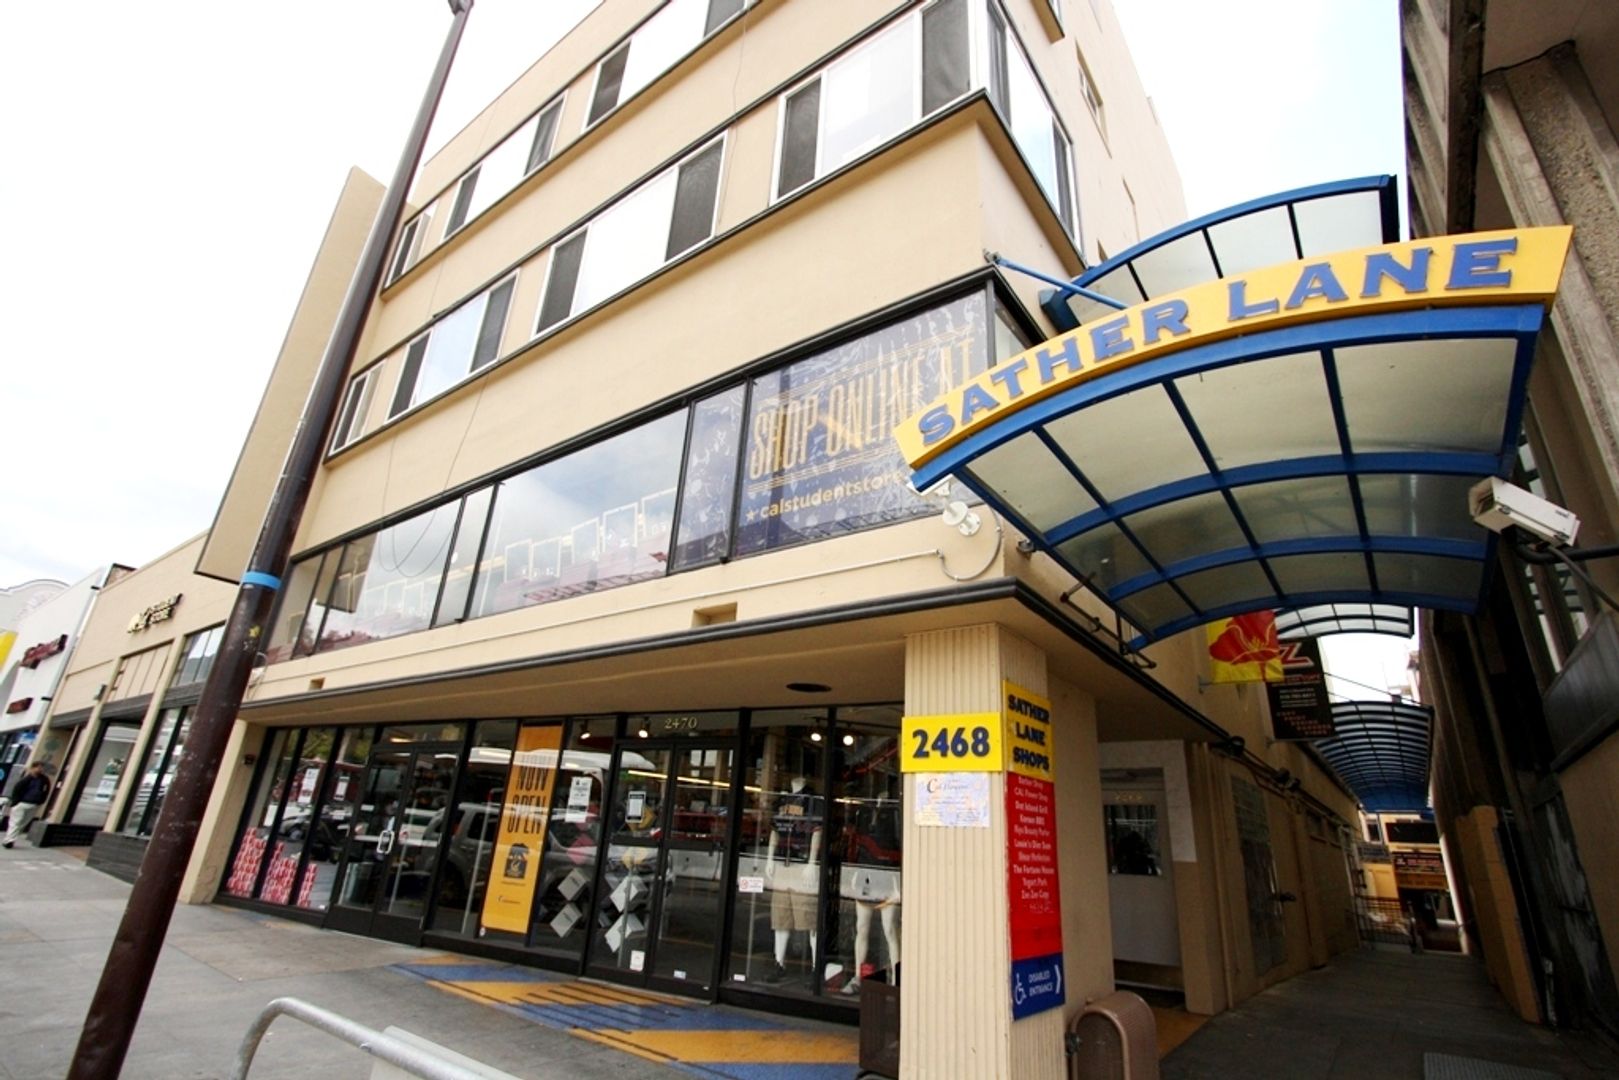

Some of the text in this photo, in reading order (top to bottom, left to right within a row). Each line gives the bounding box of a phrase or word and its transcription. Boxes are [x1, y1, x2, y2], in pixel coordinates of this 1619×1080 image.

[918, 236, 1519, 446] SATHER LANE
[751, 392, 819, 480] SHOP
[825, 350, 925, 457] ONLINE
[664, 717, 698, 729] 2470
[1008, 694, 1050, 725] SATHER
[912, 726, 991, 759] 2468
[1015, 722, 1046, 746] LANE
[515, 754, 549, 791] NOW
[1012, 746, 1050, 771] SHOPS
[507, 794, 547, 834] OPEN
